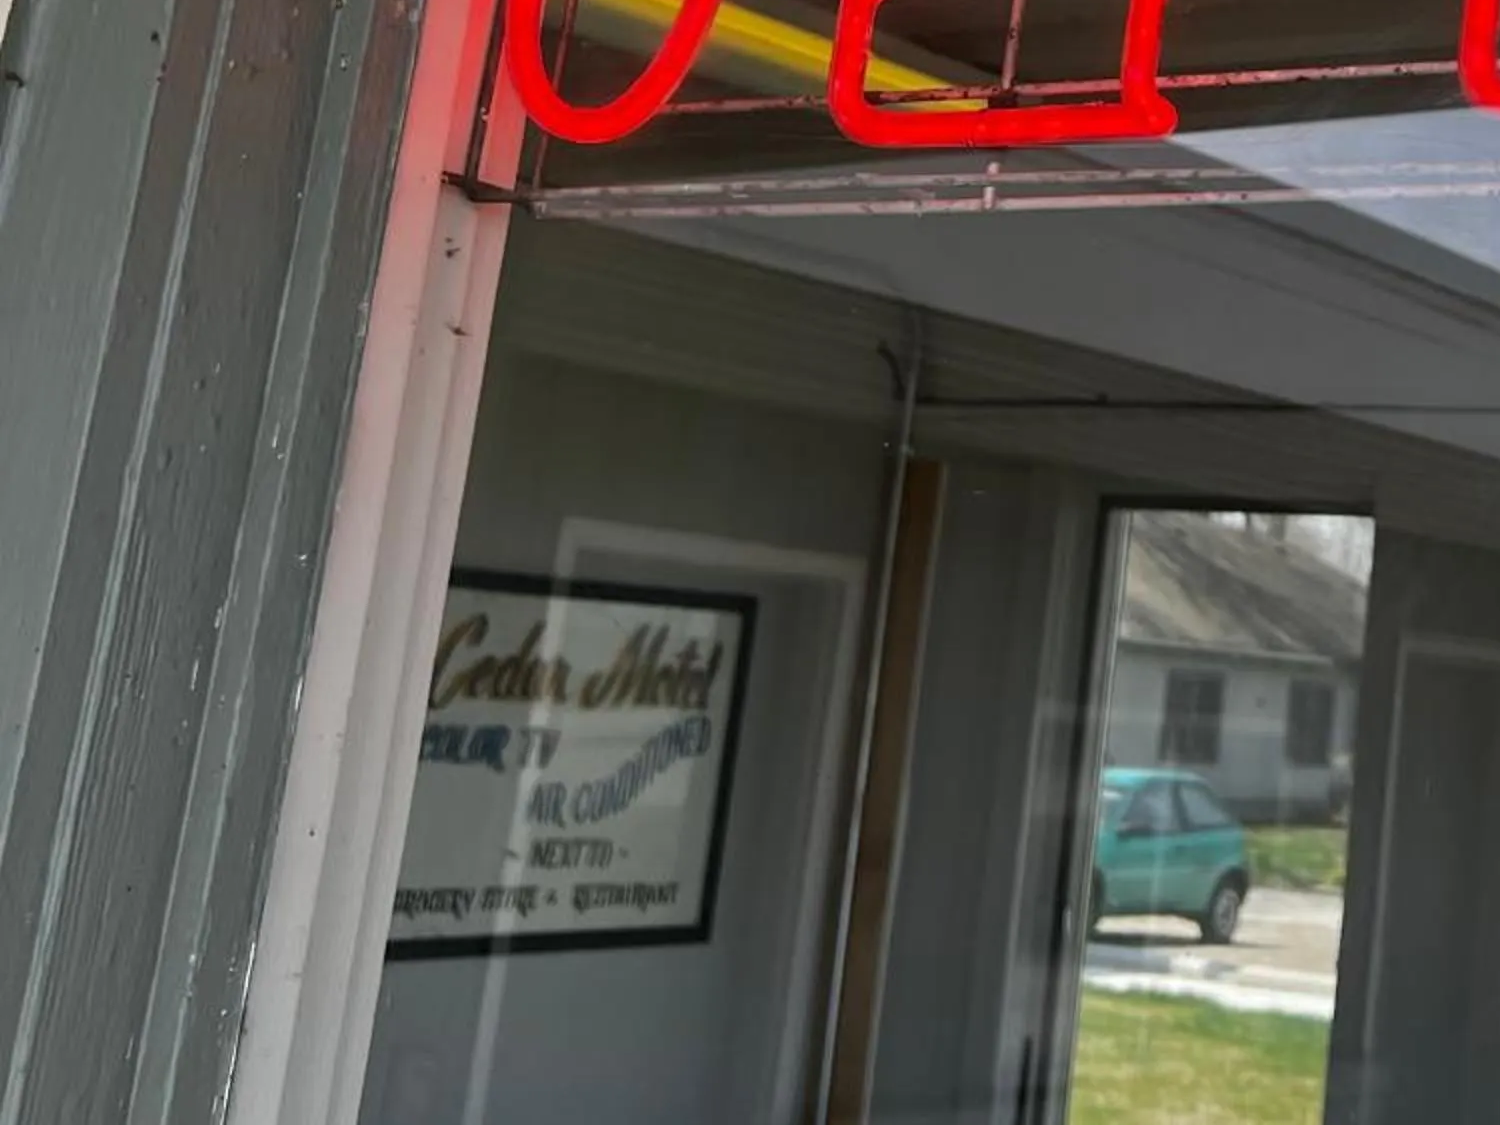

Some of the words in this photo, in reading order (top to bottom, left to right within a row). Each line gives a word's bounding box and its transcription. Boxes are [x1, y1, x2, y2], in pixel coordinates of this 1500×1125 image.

[577, 623, 725, 711] Motel
[526, 781, 568, 829] AIR
[572, 715, 712, 825] CONDITIONED
[572, 881, 680, 914] RESTAURANT
